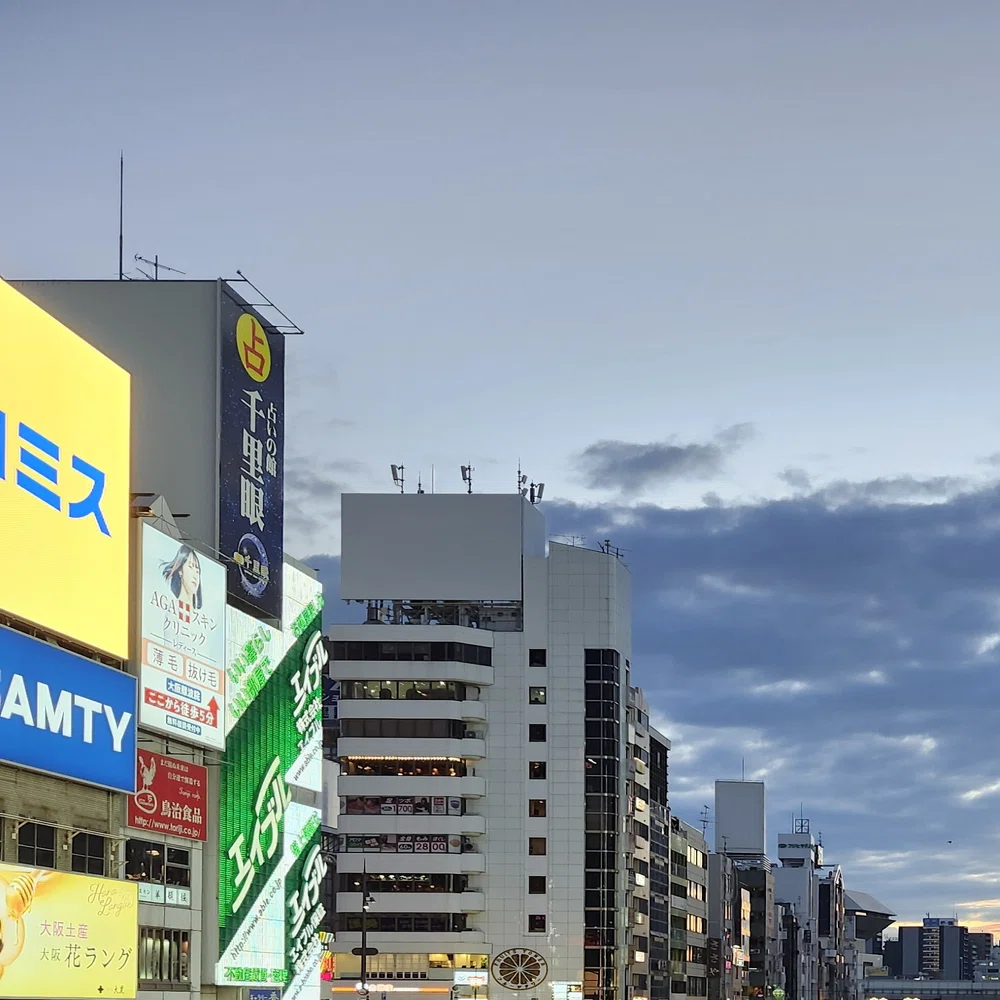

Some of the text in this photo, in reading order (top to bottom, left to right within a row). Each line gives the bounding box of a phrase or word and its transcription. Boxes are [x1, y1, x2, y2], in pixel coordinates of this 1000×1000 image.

[242, 318, 264, 378] 占
[0, 409, 112, 538] ミス
[240, 388, 266, 532] 千里眼
[265, 402, 278, 478] 占いの館
[150, 591, 217, 632] AGA スキン
[163, 617, 207, 647] クリニック
[148, 691, 215, 726] ここから徒歩5分
[187, 662, 217, 688] 抜け毛
[290, 630, 328, 718] エイブル
[0, 672, 132, 753] AMTY
[228, 758, 292, 913] エイブル
[231, 876, 284, 961] http://www.able.co.jp
[289, 844, 328, 938] エイブル
[40, 920, 88, 939] 大阪土産
[65, 943, 132, 971] 花ラング
